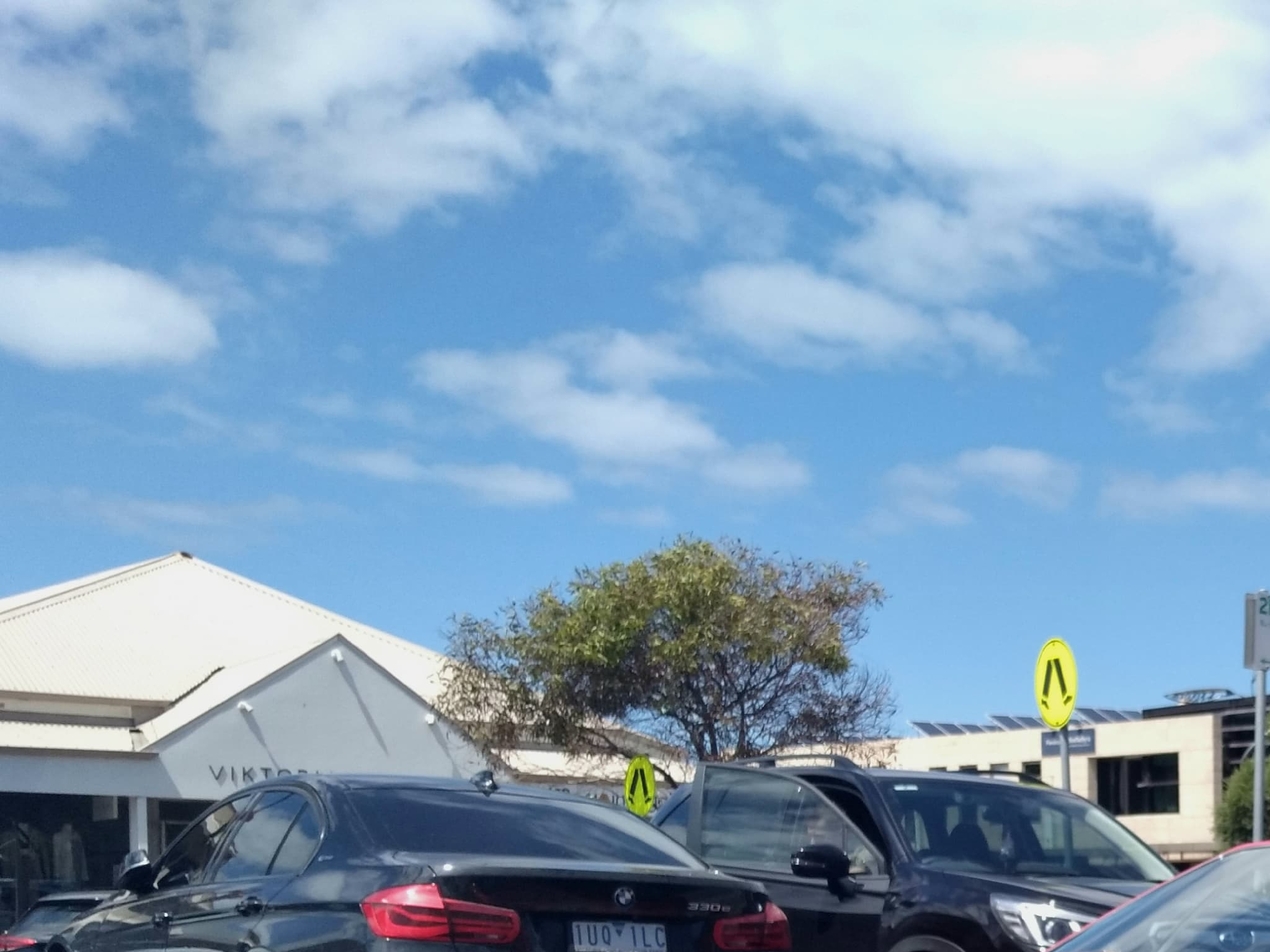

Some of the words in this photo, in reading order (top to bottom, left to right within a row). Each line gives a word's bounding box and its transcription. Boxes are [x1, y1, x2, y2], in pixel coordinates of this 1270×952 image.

[687, 902, 731, 912] 330e
[576, 924, 611, 946] 1UQ
[630, 926, 666, 949] 1LC
